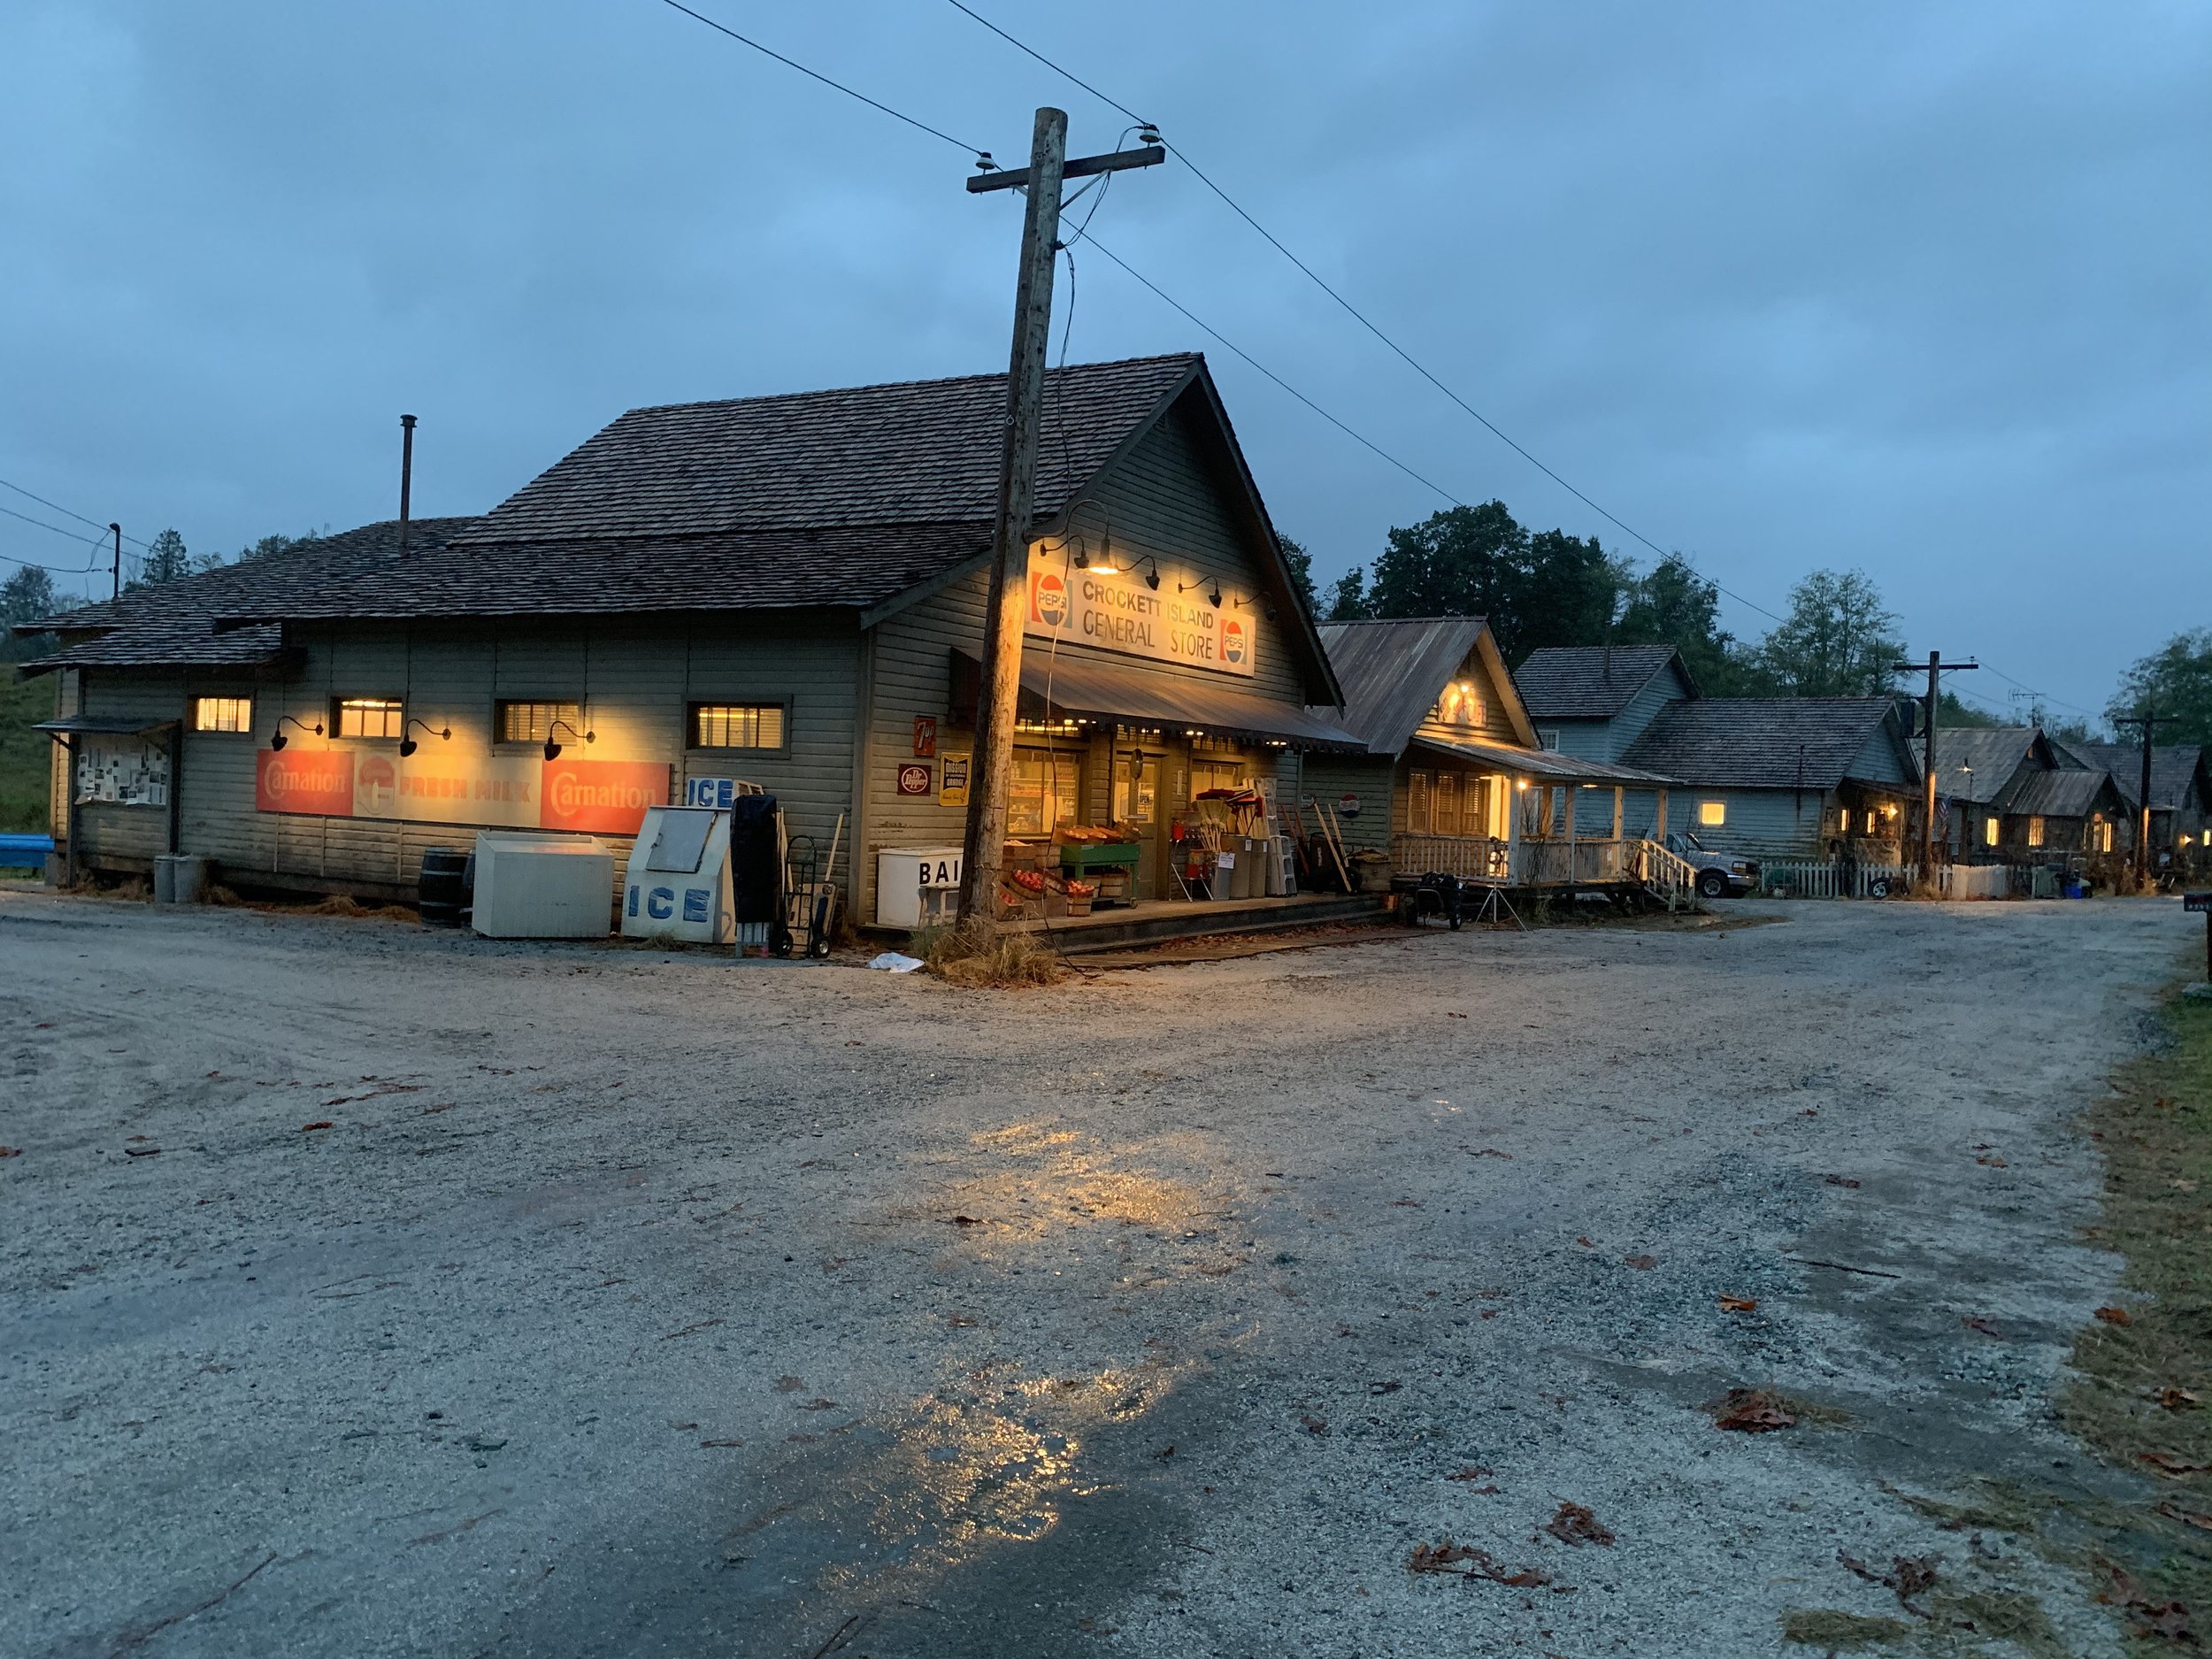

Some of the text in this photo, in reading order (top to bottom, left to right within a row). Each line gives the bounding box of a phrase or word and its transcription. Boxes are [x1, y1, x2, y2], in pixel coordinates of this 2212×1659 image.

[1038, 592, 1067, 610] PEPSI
[1082, 580, 1214, 629] CROCKETT ISLAND
[1083, 610, 1213, 660] GENERAL STORE
[1225, 635, 1244, 649] PEPSI
[265, 760, 347, 800] Carnation
[400, 776, 531, 803] FRESH MILK
[550, 772, 658, 817] Carnation
[688, 779, 734, 808] ICE
[905, 774, 927, 789] Pepper
[919, 860, 958, 885] BAI
[628, 885, 710, 923] ICE
